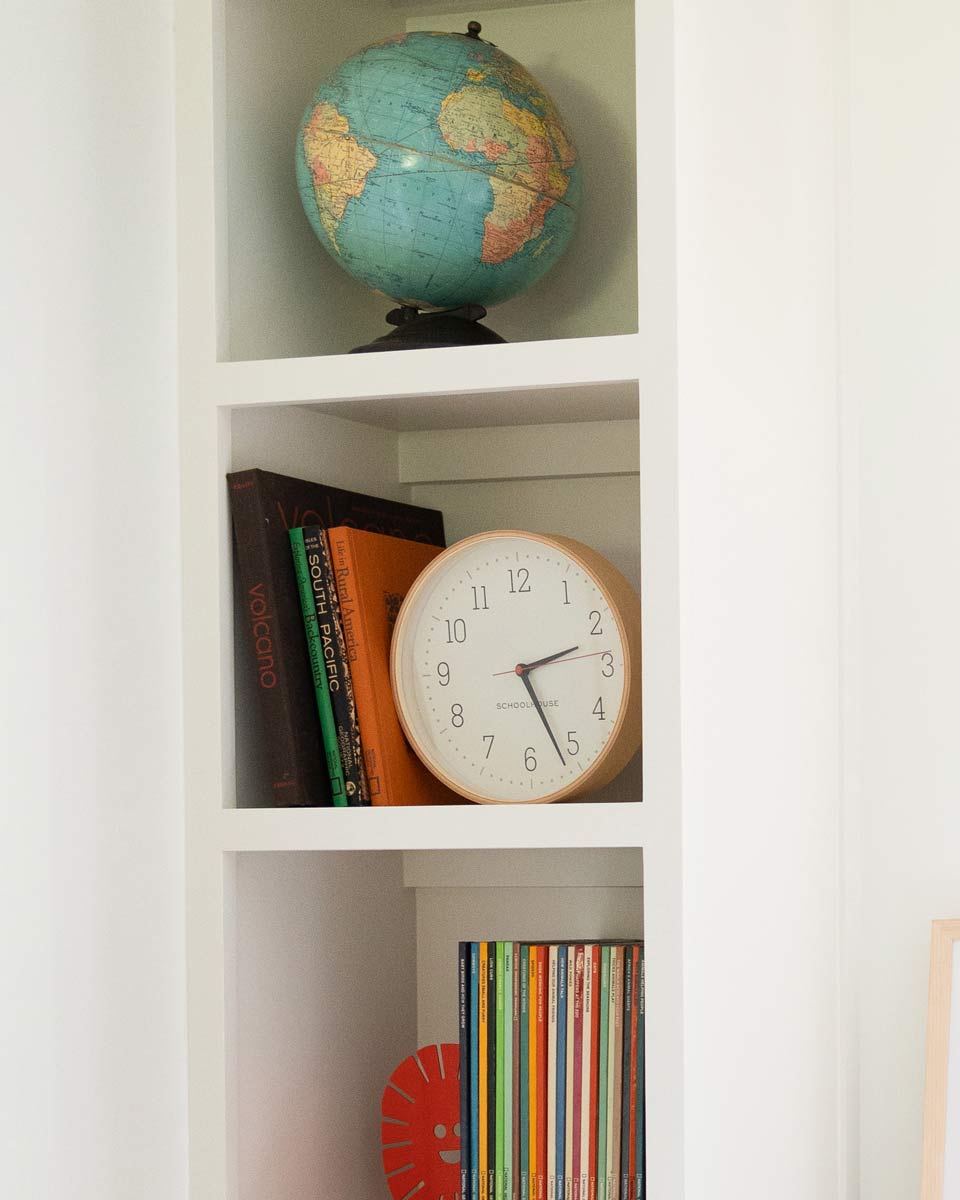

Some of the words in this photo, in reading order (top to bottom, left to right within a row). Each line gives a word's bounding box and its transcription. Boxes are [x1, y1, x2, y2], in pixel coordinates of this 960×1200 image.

[337, 568, 351, 603] Rural
[508, 569, 531, 594] 12
[562, 581, 571, 605] 1
[472, 586, 490, 610] 11
[308, 554, 328, 614] SOUTH
[320, 624, 339, 692] PACIFIC
[343, 608, 359, 662] America
[446, 619, 467, 643] 10
[589, 611, 602, 636] 2
[249, 584, 277, 689] volcano
[304, 613, 322, 689] Backcountry
[437, 662, 450, 686] 9
[600, 652, 615, 678] 3
[451, 704, 464, 728] 8
[592, 697, 606, 721] 4
[483, 735, 495, 759] 7
[567, 731, 579, 756] 5
[525, 747, 537, 772] 6
